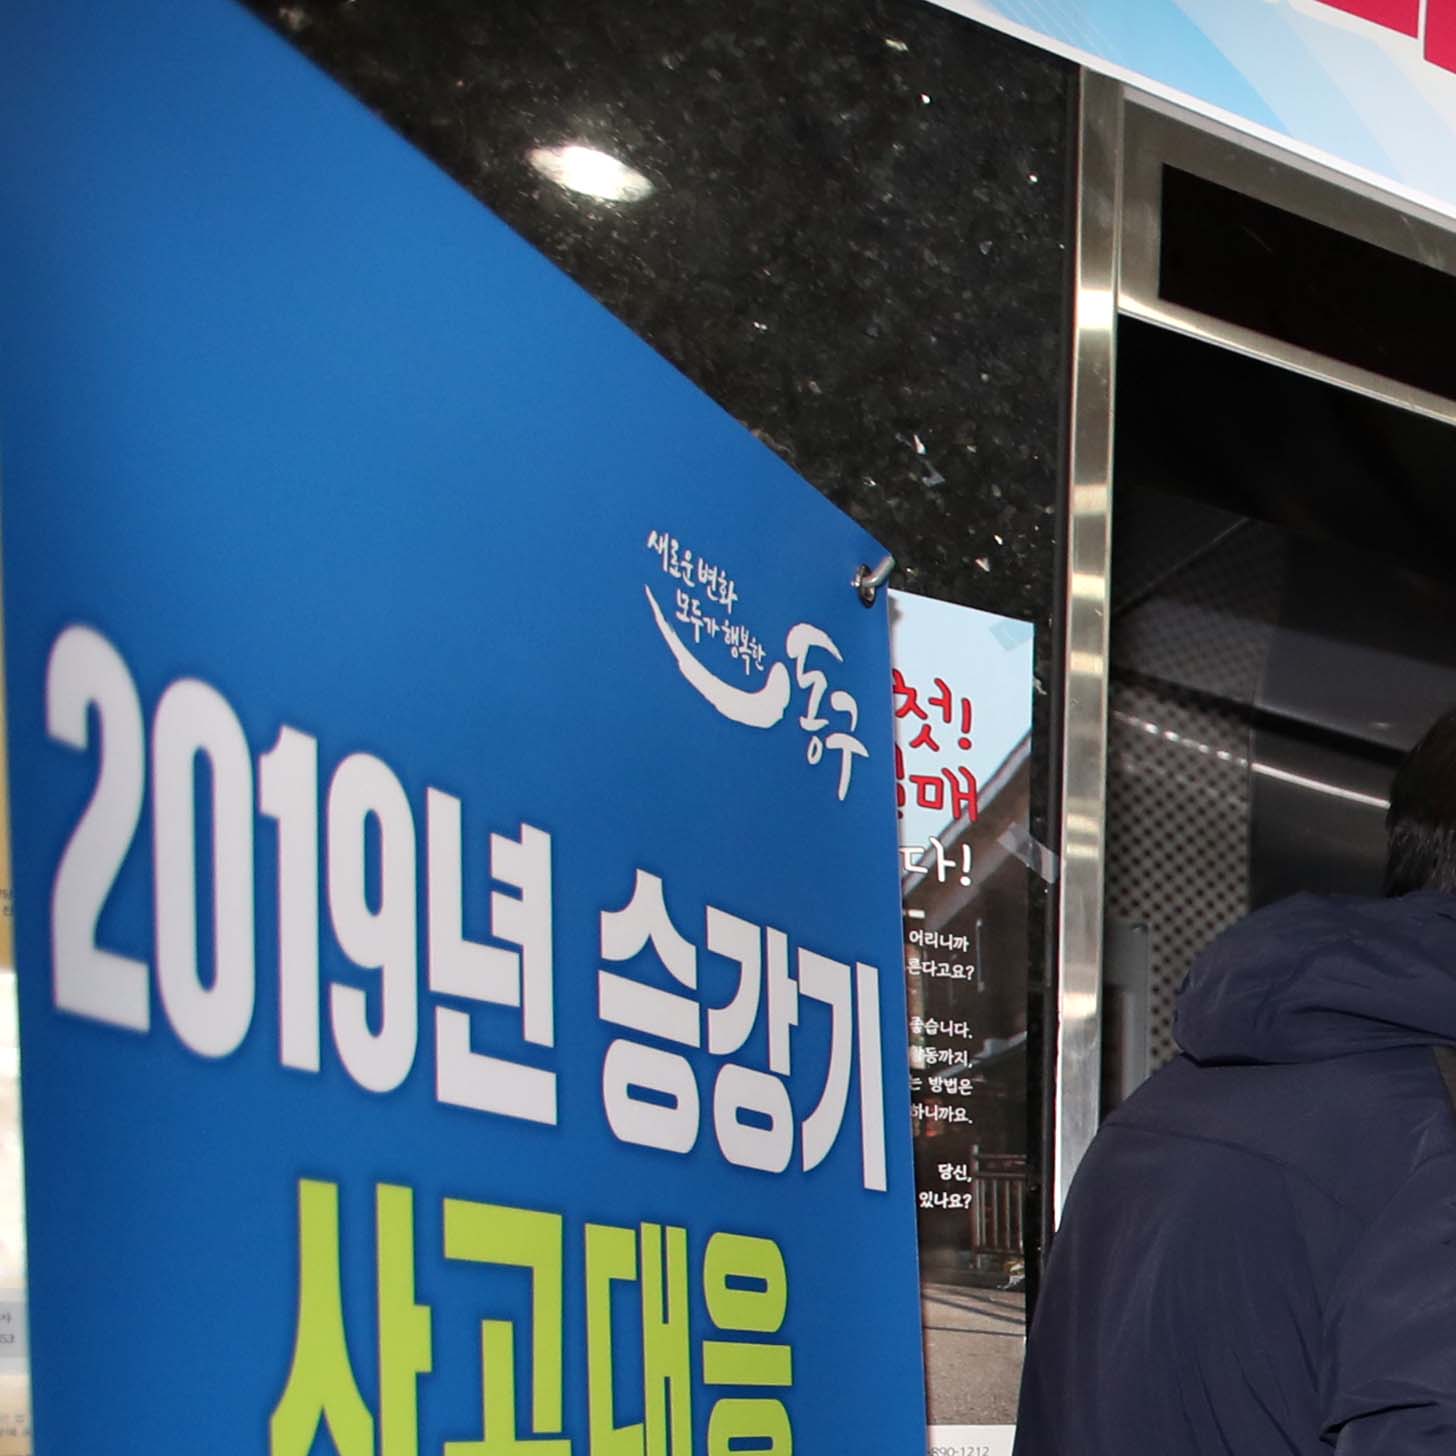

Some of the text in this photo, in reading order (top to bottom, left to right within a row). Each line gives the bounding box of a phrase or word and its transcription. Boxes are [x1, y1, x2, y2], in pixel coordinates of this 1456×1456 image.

[647, 530, 739, 615] 새로운 변화
[675, 587, 767, 676] 모두가 행복한
[786, 623, 870, 801] 동구
[895, 742, 979, 822] 매
[45, 623, 888, 1193] 2019년 승강기
[908, 929, 970, 953] 어리니까
[928, 1076, 974, 1096] 방법은
[919, 1191, 973, 1211] 있나요?
[938, 1163, 973, 1183] 당신,
